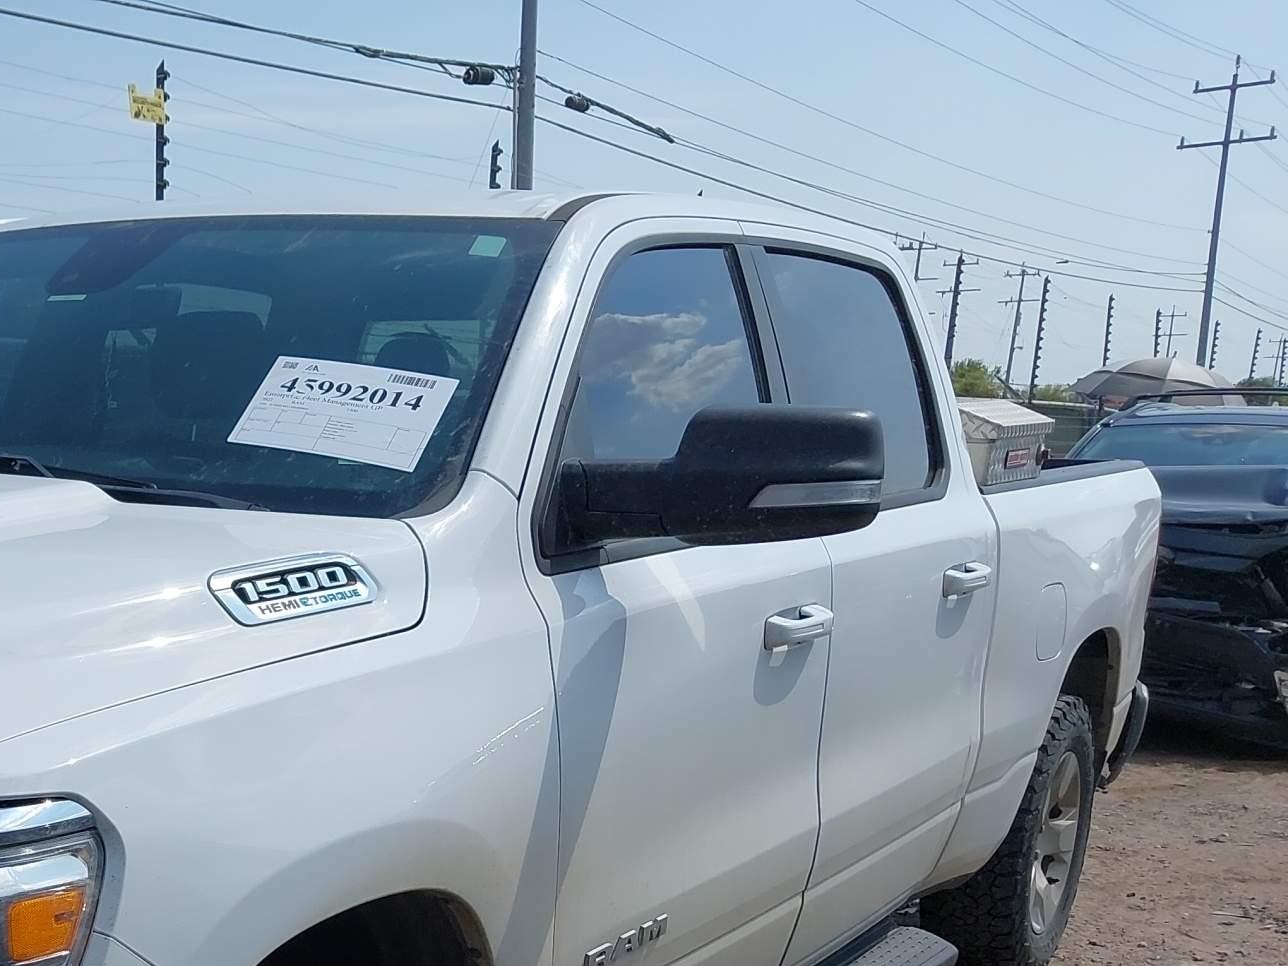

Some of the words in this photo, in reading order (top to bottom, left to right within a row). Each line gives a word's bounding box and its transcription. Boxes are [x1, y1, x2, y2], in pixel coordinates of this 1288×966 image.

[280, 377, 424, 411] 45992014
[235, 565, 349, 602] 1500
[258, 599, 300, 615] HEMI
